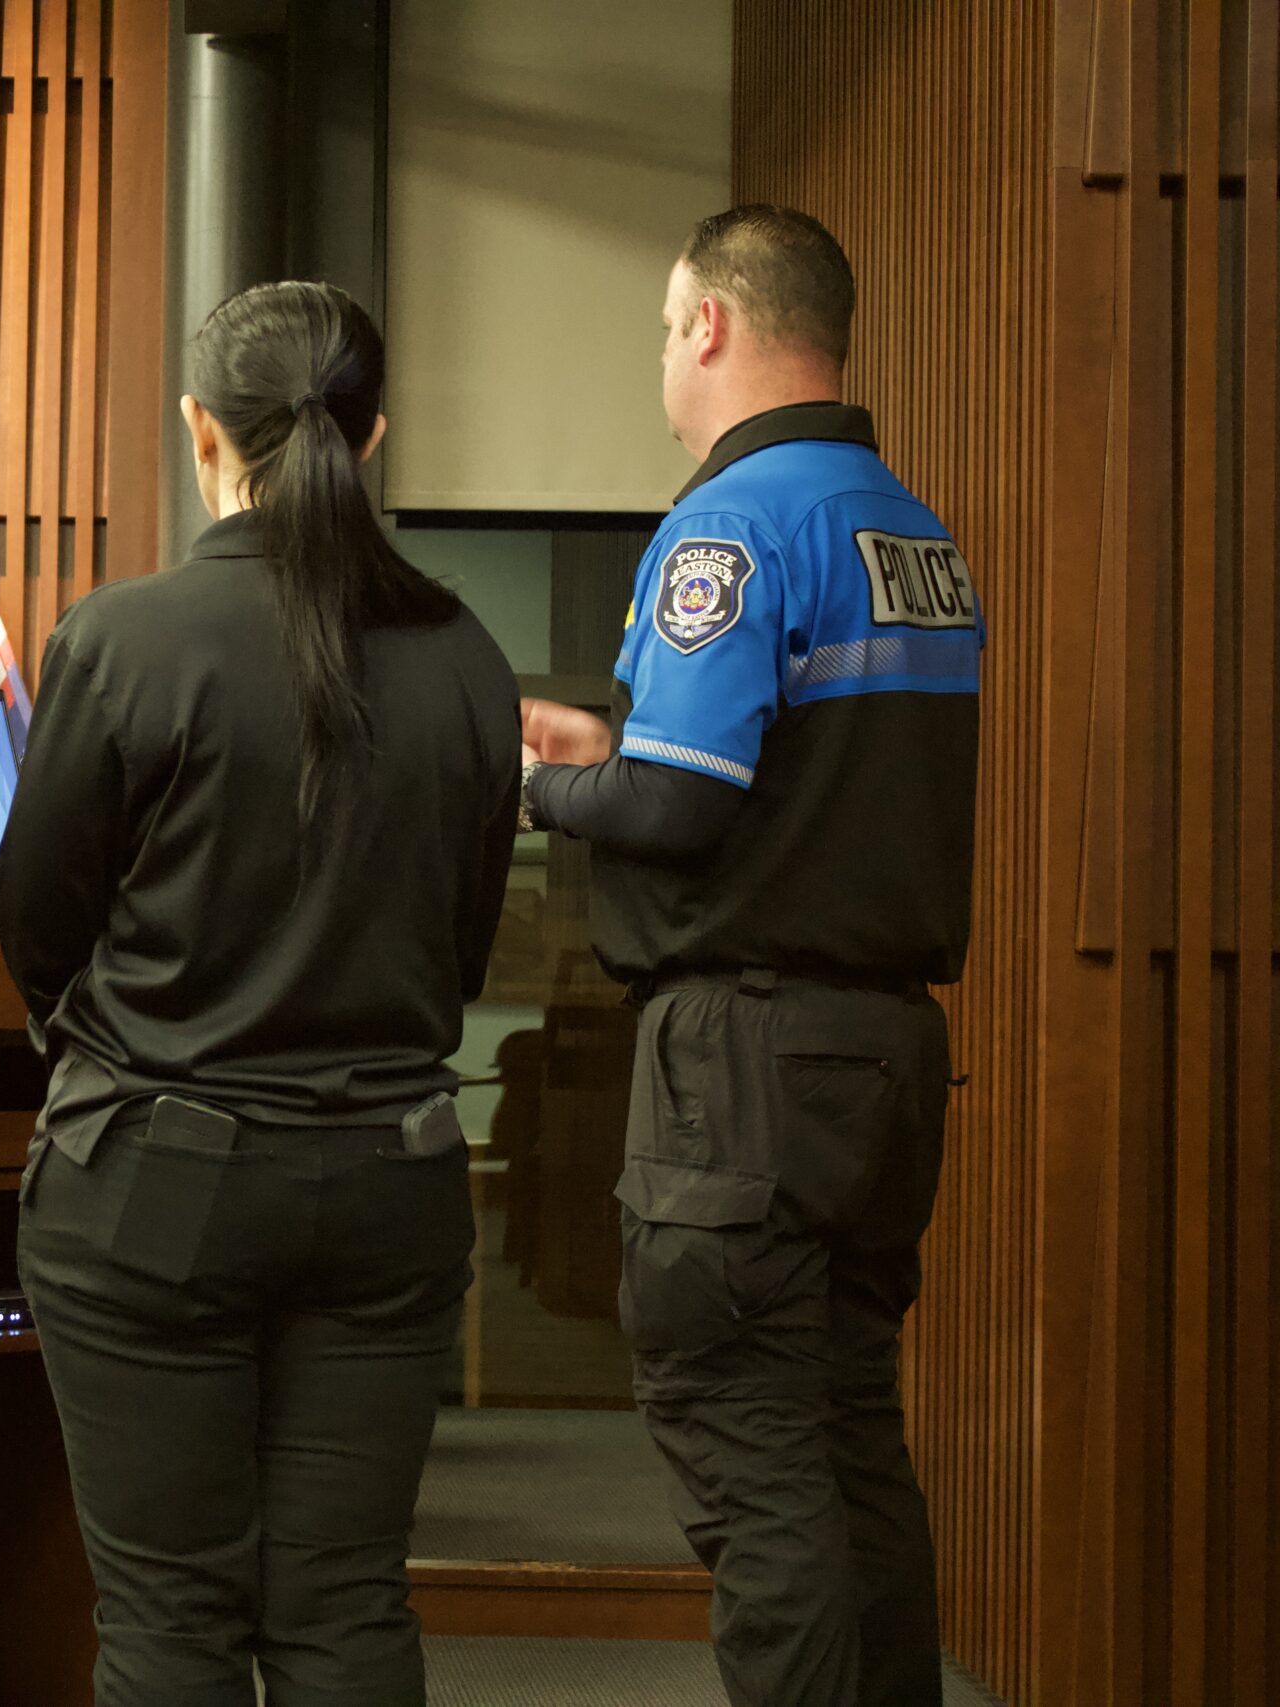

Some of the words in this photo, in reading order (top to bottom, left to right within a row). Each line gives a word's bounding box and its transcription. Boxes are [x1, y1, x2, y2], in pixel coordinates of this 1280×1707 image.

[676, 548, 737, 566] POLICE
[677, 562, 729, 577] EASTON
[872, 538, 974, 617] POLICE
